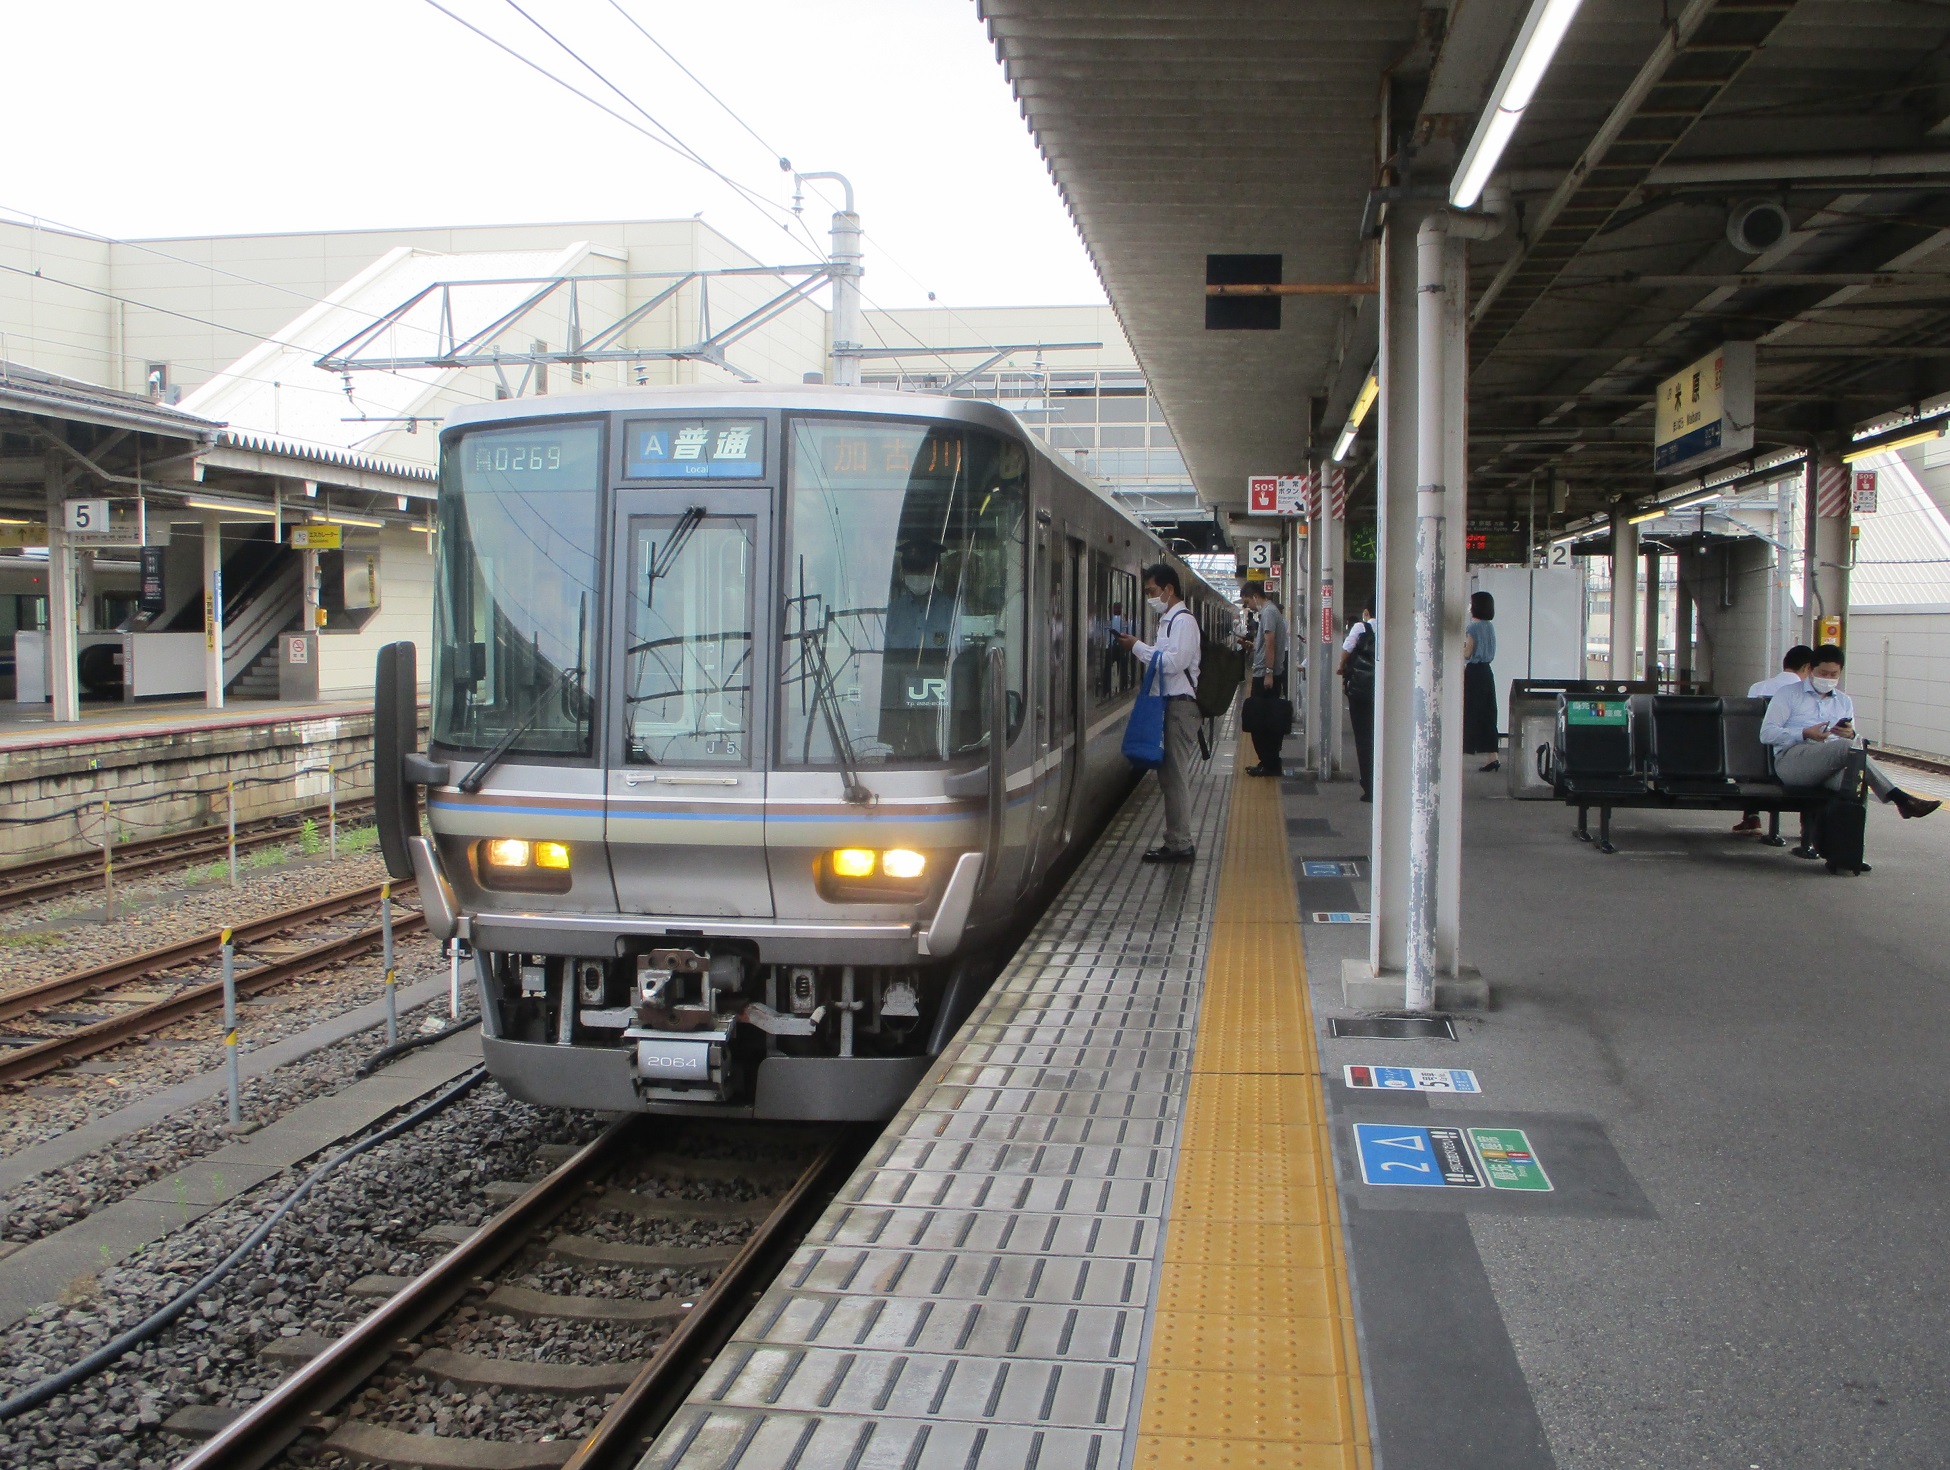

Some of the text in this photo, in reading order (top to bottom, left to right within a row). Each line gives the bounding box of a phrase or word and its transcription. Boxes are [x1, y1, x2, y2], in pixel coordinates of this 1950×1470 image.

[1674, 371, 1701, 412] 米原
[644, 426, 753, 460] A 普通
[834, 437, 962, 473] 加古川
[685, 464, 709, 475] Local
[1254, 483, 1275, 492] SOS
[76, 504, 90, 528] 5
[1512, 521, 1520, 532] 2
[1253, 544, 1267, 565] 3
[1553, 545, 1567, 565] 2
[908, 678, 948, 700] JR
[707, 742, 735, 754] J 5
[647, 1056, 697, 1068] 2064
[1380, 1161, 1431, 1173] 2
[1476, 1135, 1519, 1181] 優先 座席
